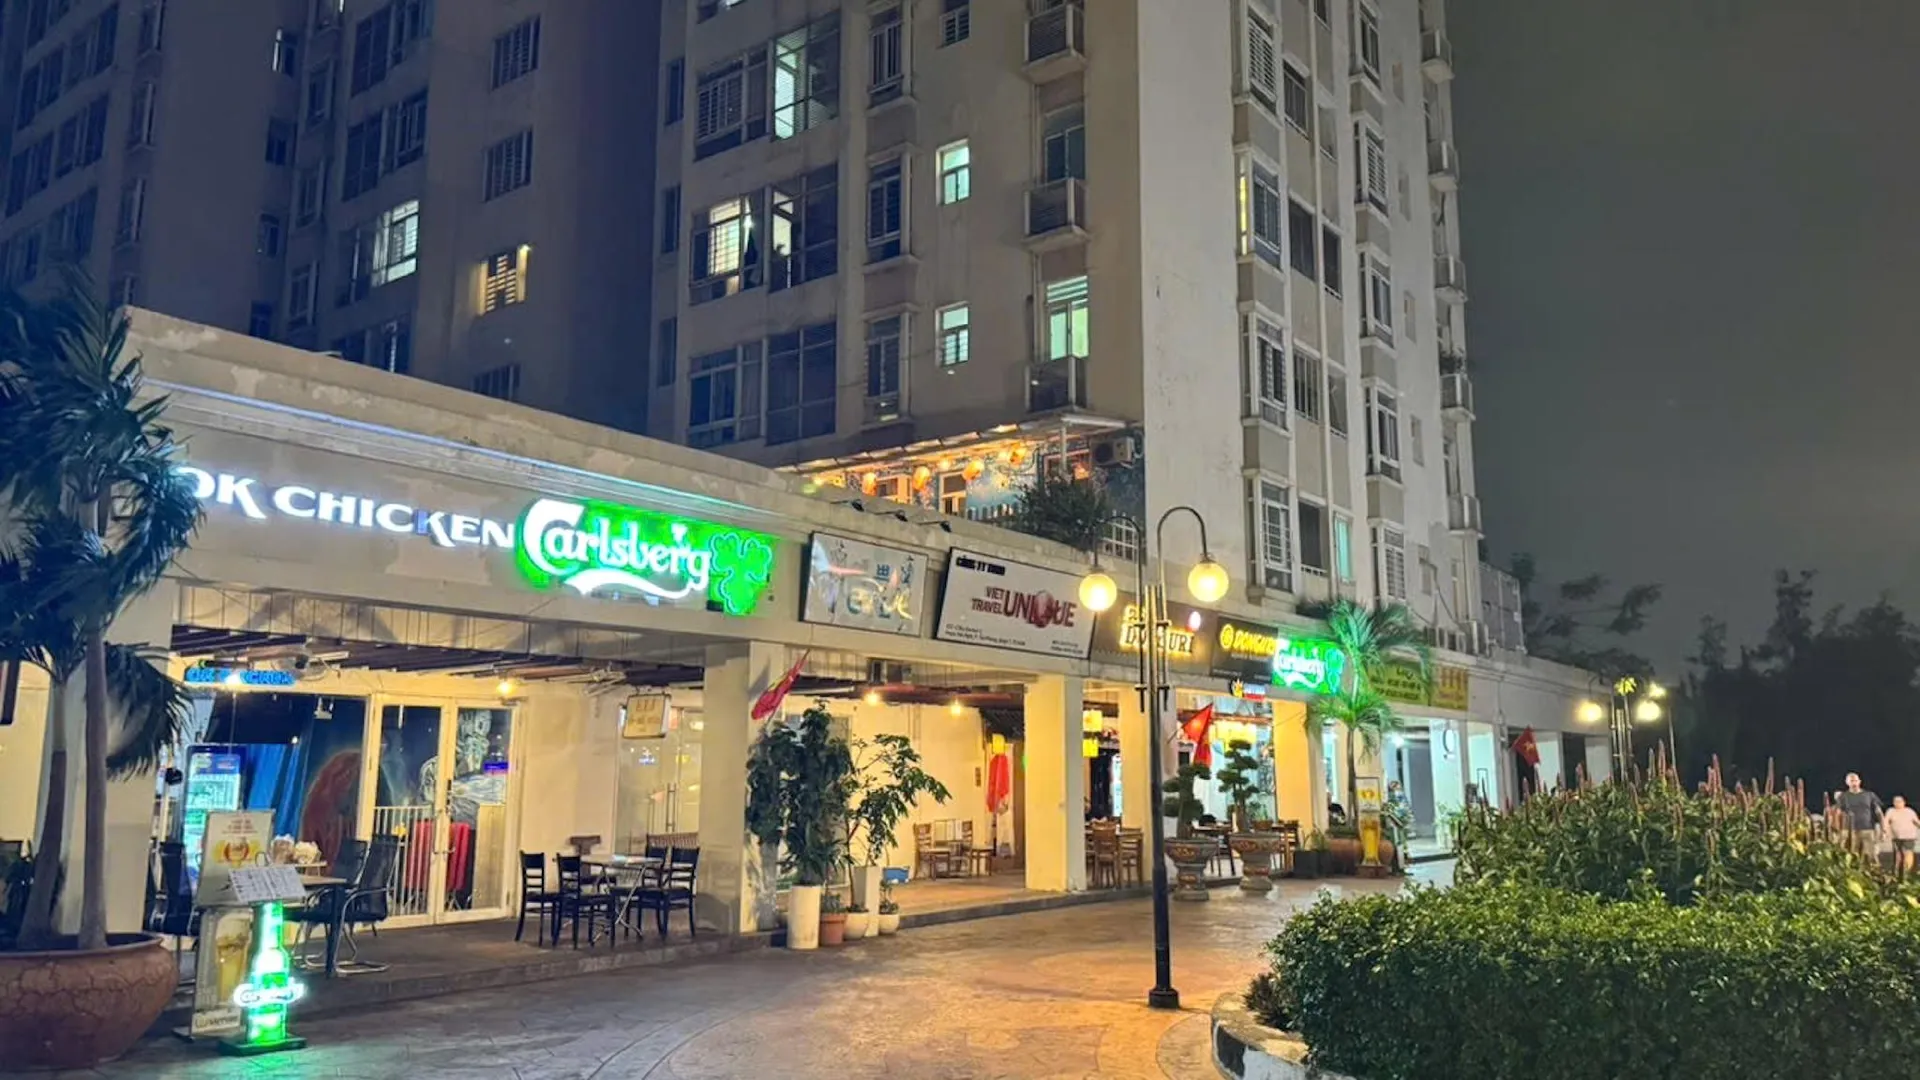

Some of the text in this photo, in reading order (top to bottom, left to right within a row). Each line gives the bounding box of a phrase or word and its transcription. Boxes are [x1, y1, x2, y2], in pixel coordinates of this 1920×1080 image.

[273, 485, 515, 547] CHICKEN
[523, 499, 712, 599] Carlsberg
[971, 598, 1002, 614] TRAVEL
[1004, 589, 1077, 628] UNIQUE
